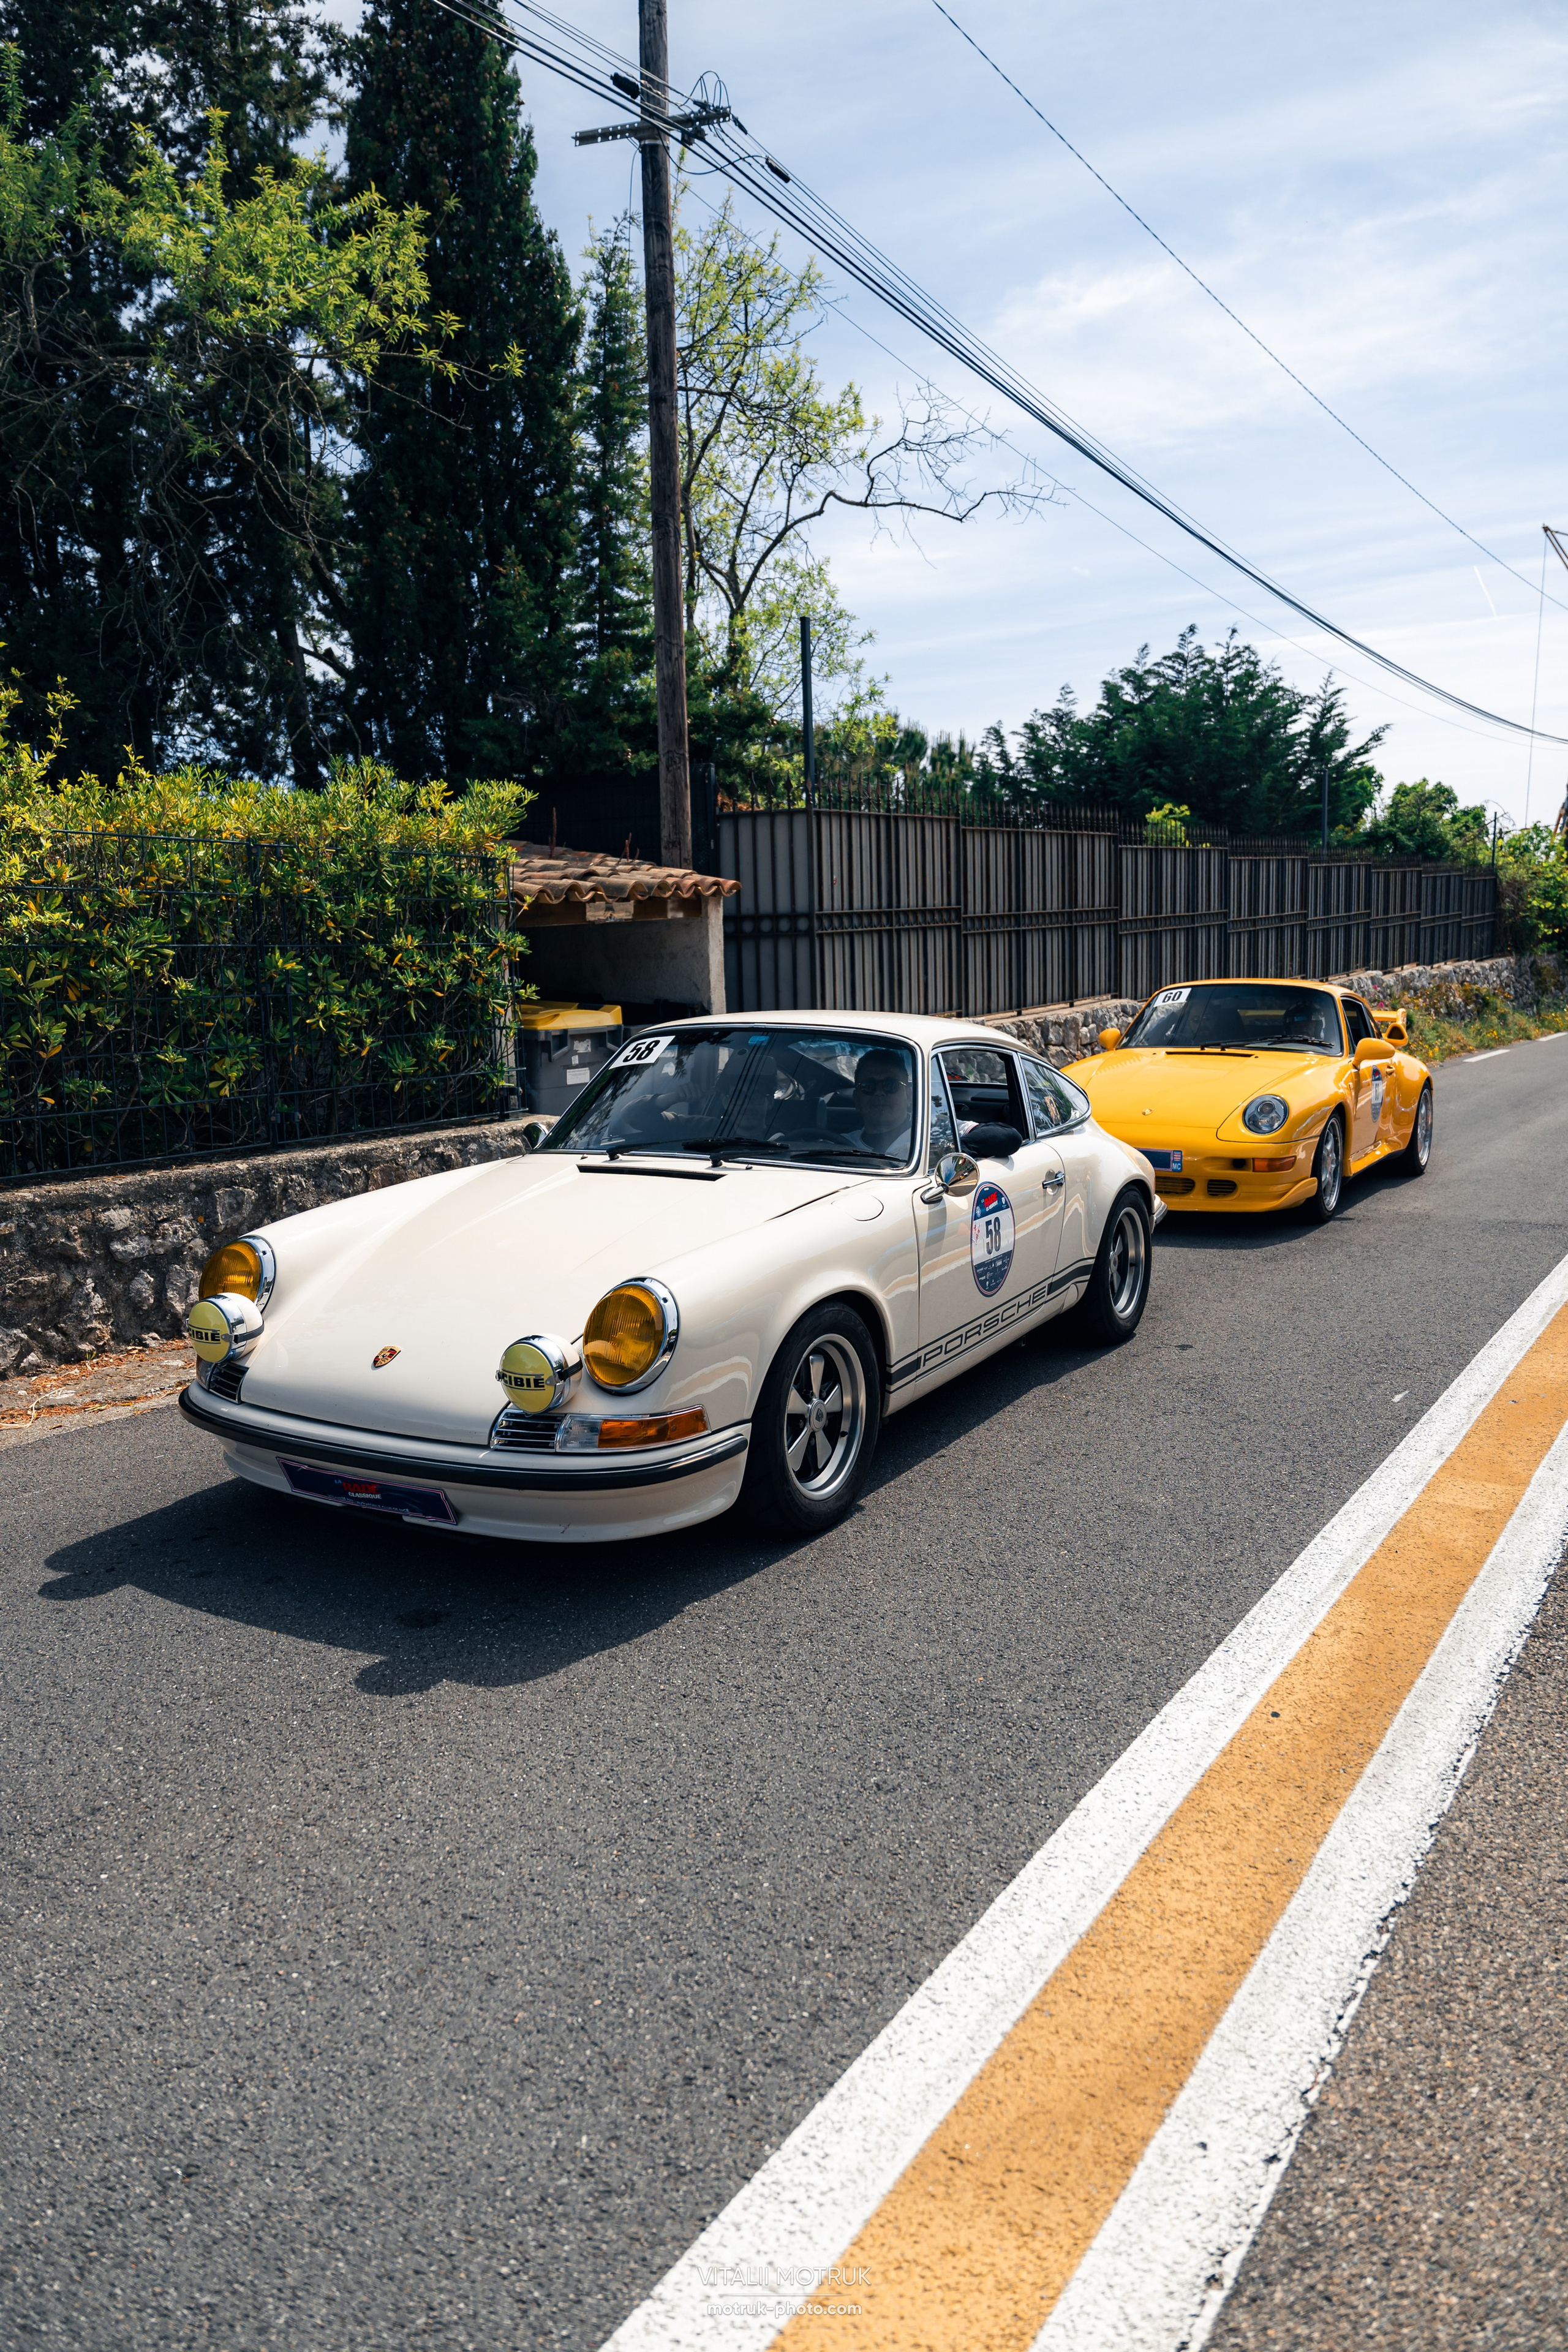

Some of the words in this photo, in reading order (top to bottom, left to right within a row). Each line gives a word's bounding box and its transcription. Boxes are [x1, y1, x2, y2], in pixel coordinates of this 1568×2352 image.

[1162, 990, 1183, 1003] 60
[622, 1039, 660, 1063] 58
[985, 1216, 1001, 1255] 58
[922, 1285, 1047, 1367] PORSCHE
[342, 1481, 380, 1494] RADE
